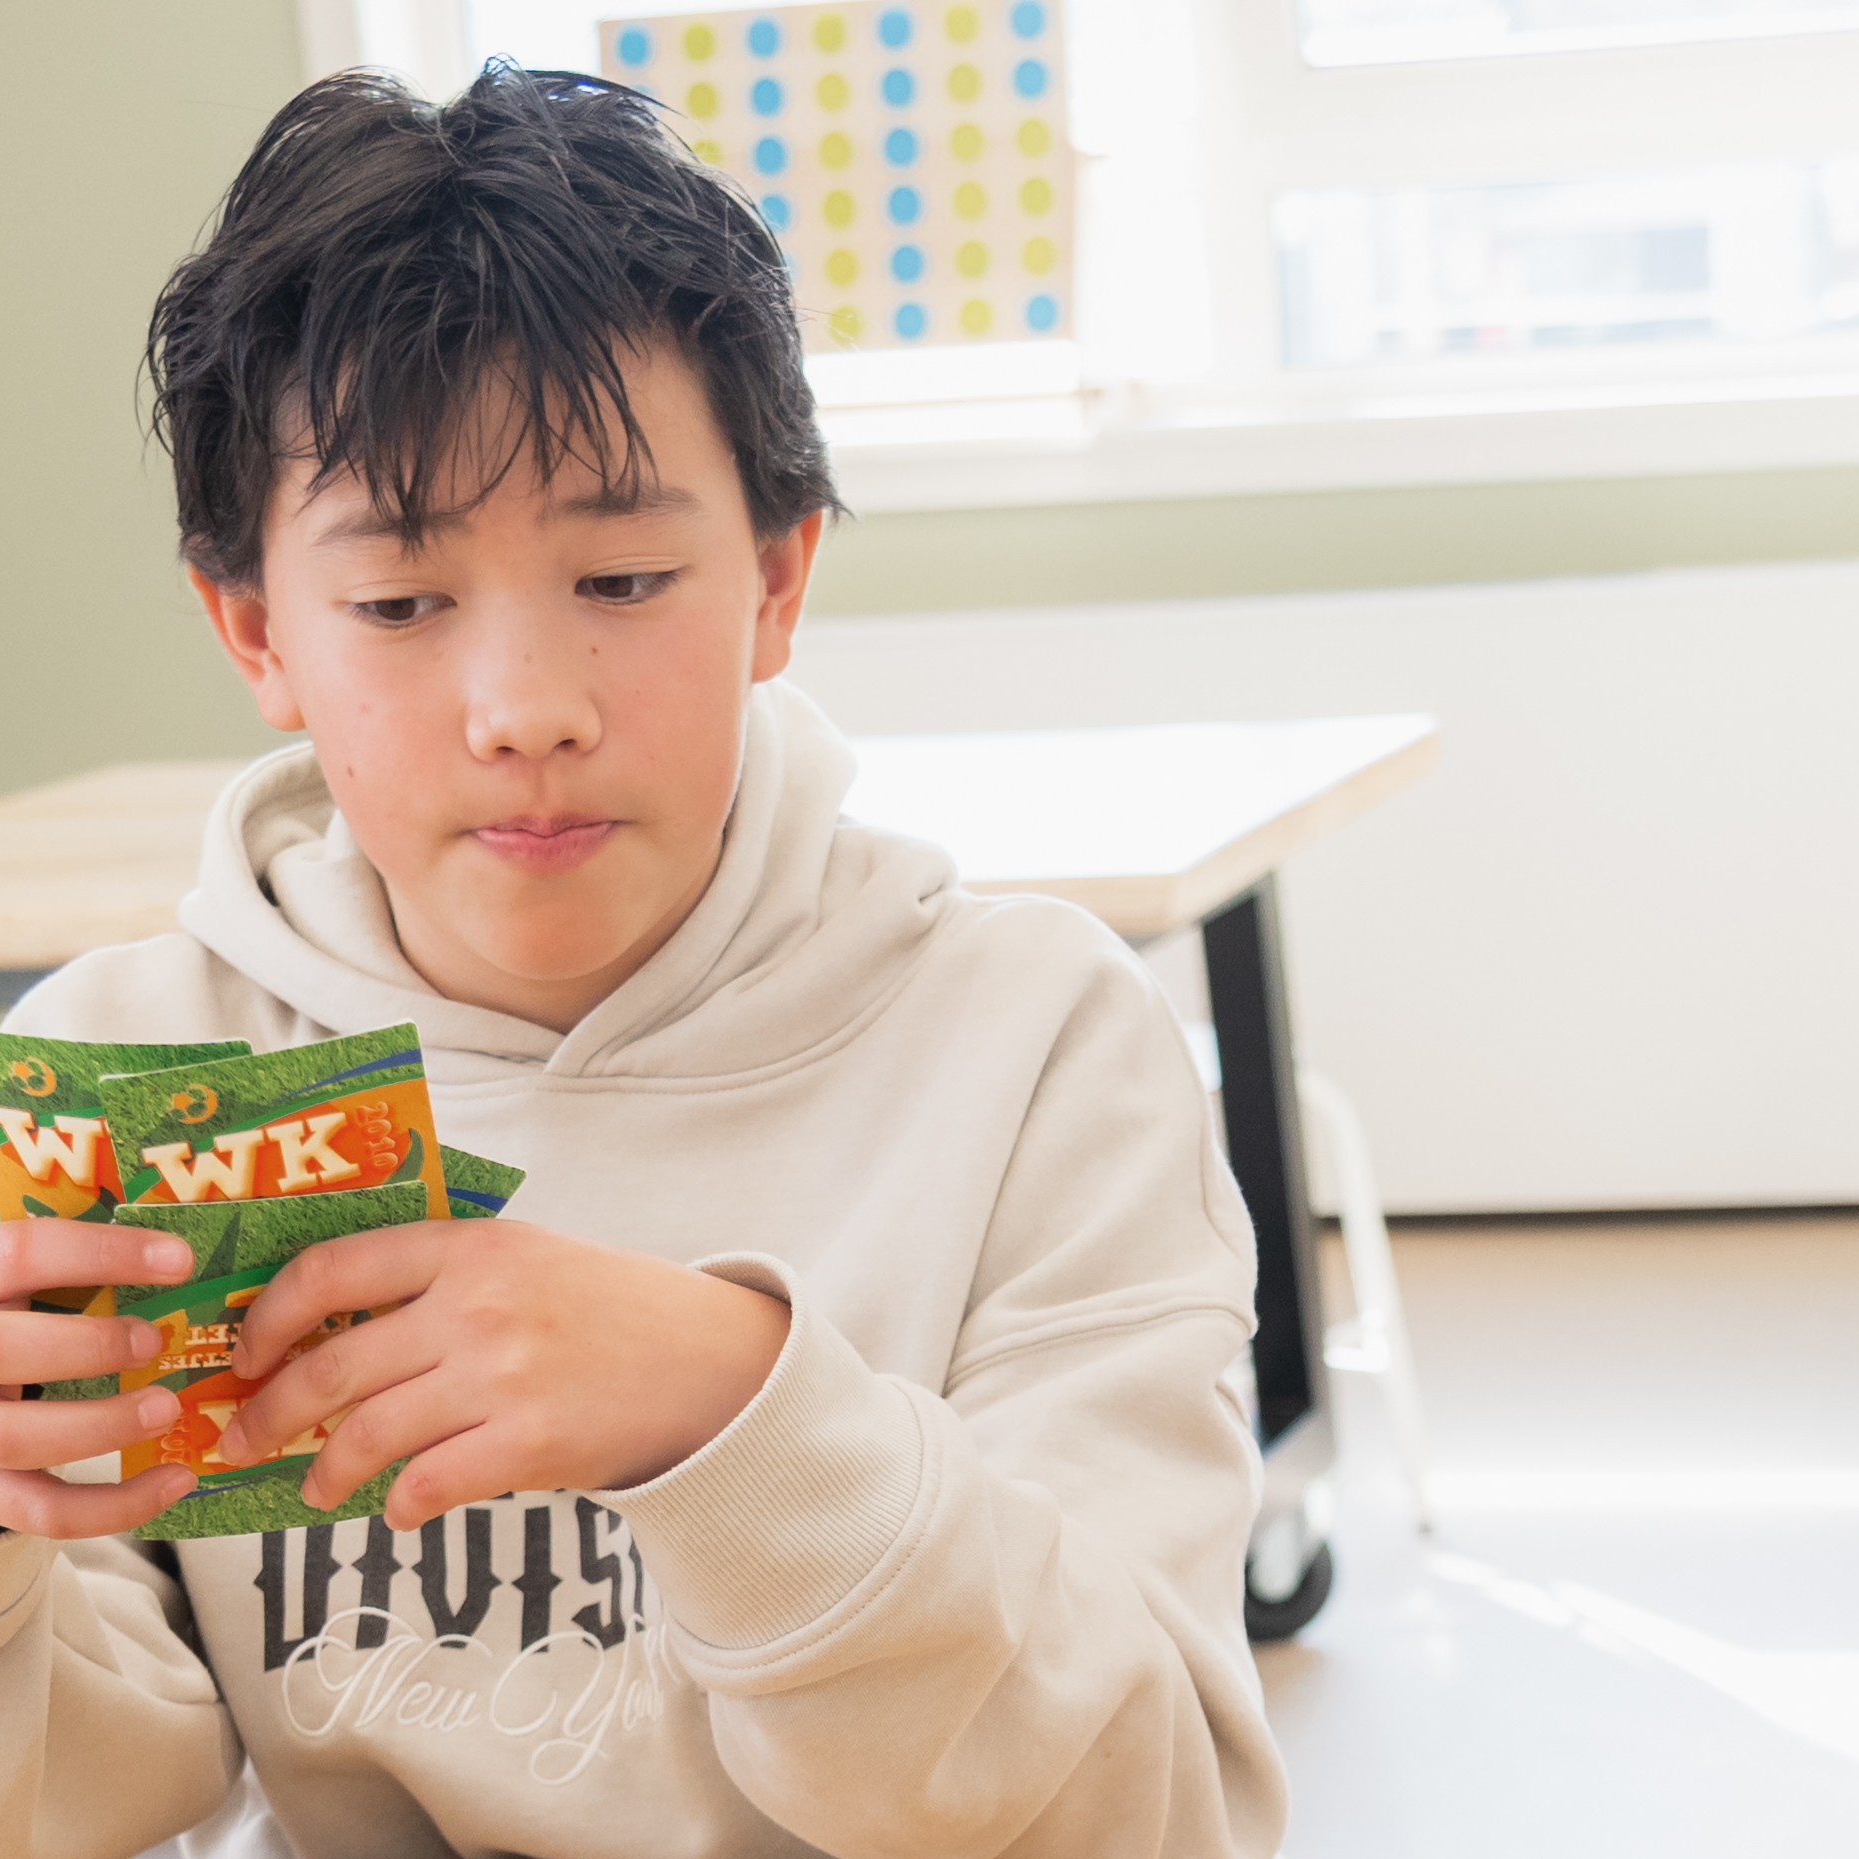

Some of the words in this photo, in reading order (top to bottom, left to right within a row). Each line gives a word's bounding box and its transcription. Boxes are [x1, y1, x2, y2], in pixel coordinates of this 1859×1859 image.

[142, 1111, 362, 1203] WK
[355, 1101, 399, 1171] 2010
[282, 1606, 494, 1737] New
